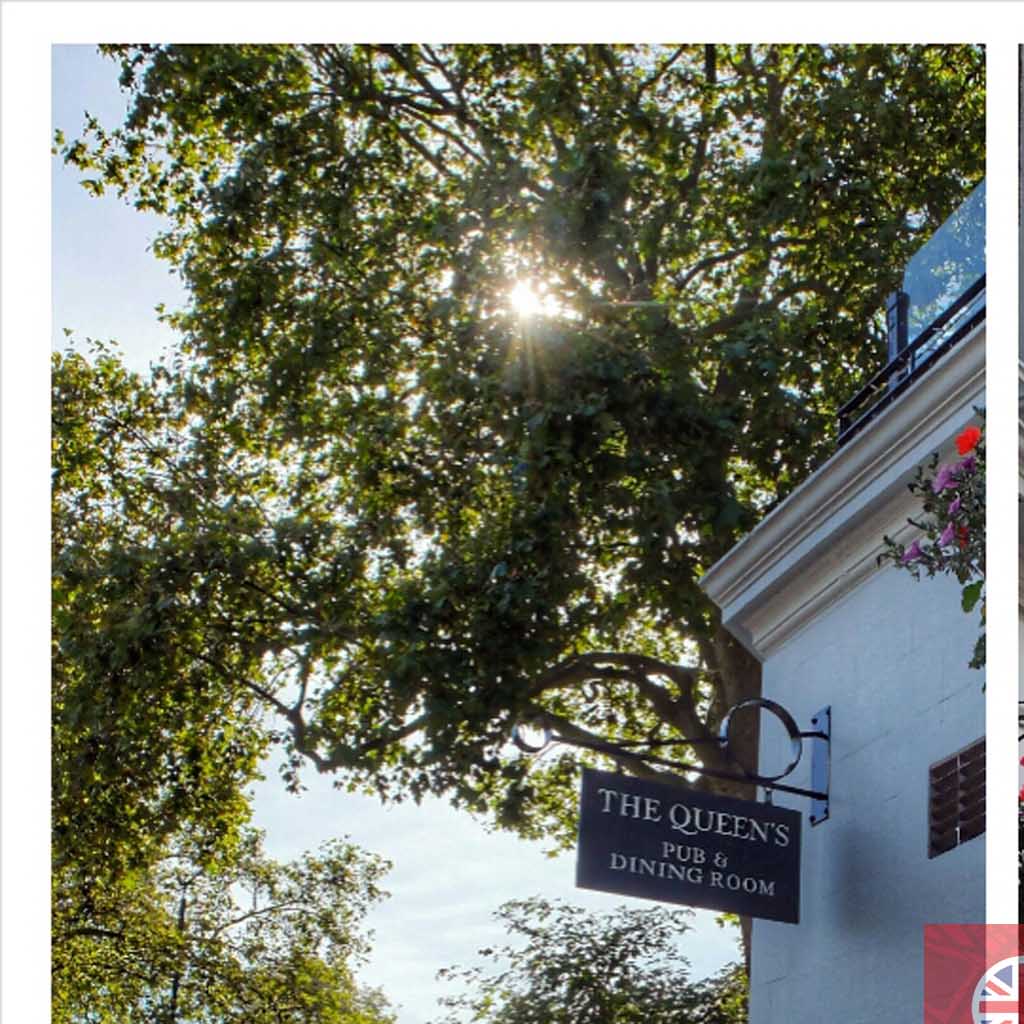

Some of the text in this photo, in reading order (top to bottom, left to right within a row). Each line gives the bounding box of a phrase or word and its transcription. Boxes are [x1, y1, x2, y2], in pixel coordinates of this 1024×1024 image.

[598, 788, 790, 847] THE QUEEN'S
[609, 852, 776, 897] DINING ROOM
[662, 841, 729, 868] PUB &
